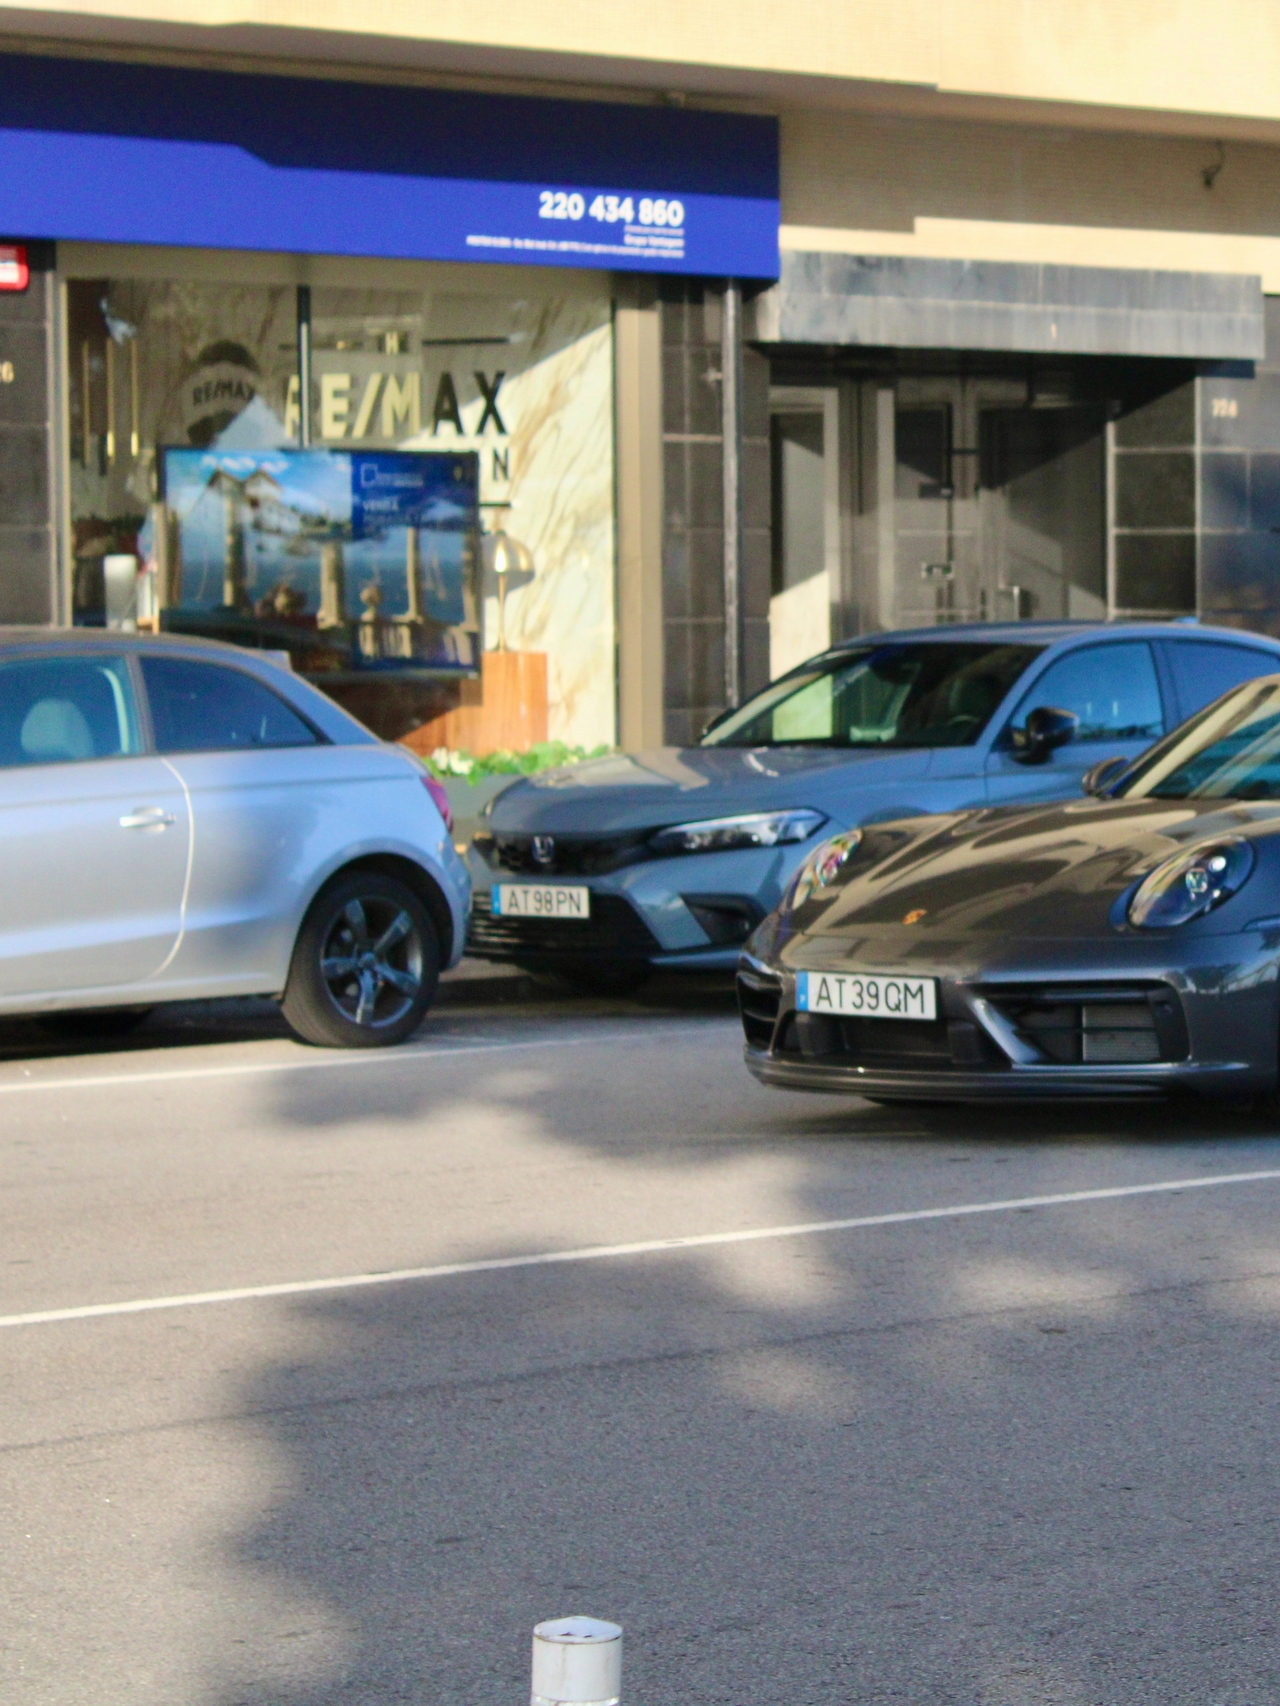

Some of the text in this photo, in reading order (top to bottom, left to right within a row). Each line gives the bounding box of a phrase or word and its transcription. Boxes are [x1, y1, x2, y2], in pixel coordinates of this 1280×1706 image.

[539, 191, 684, 226] 220 434 860
[508, 889, 581, 914] AT98PN
[815, 976, 925, 1015] AT39QM
